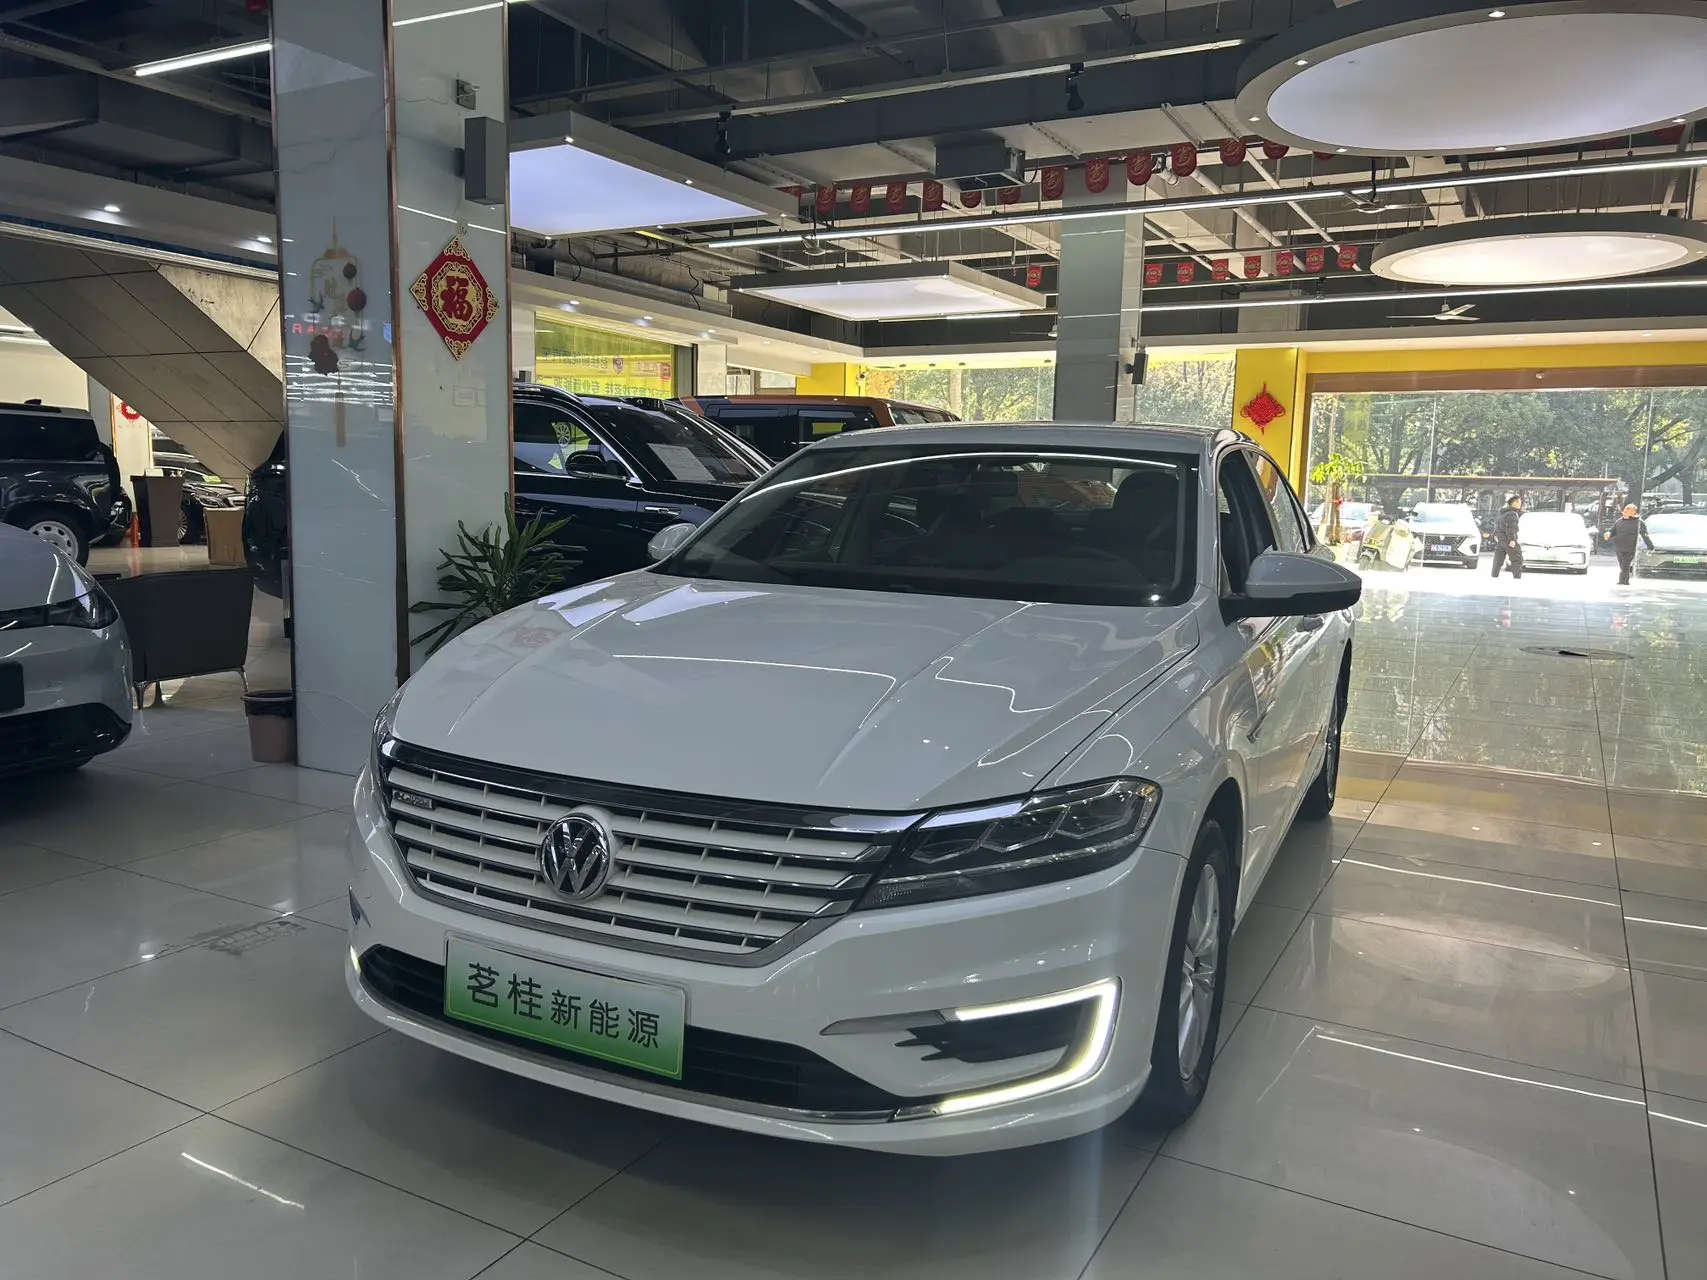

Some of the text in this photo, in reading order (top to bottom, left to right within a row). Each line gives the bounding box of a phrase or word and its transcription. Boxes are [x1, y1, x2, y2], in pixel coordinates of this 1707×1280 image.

[440, 276, 473, 321] 福
[467, 962, 660, 1049] 茗桂新能源
